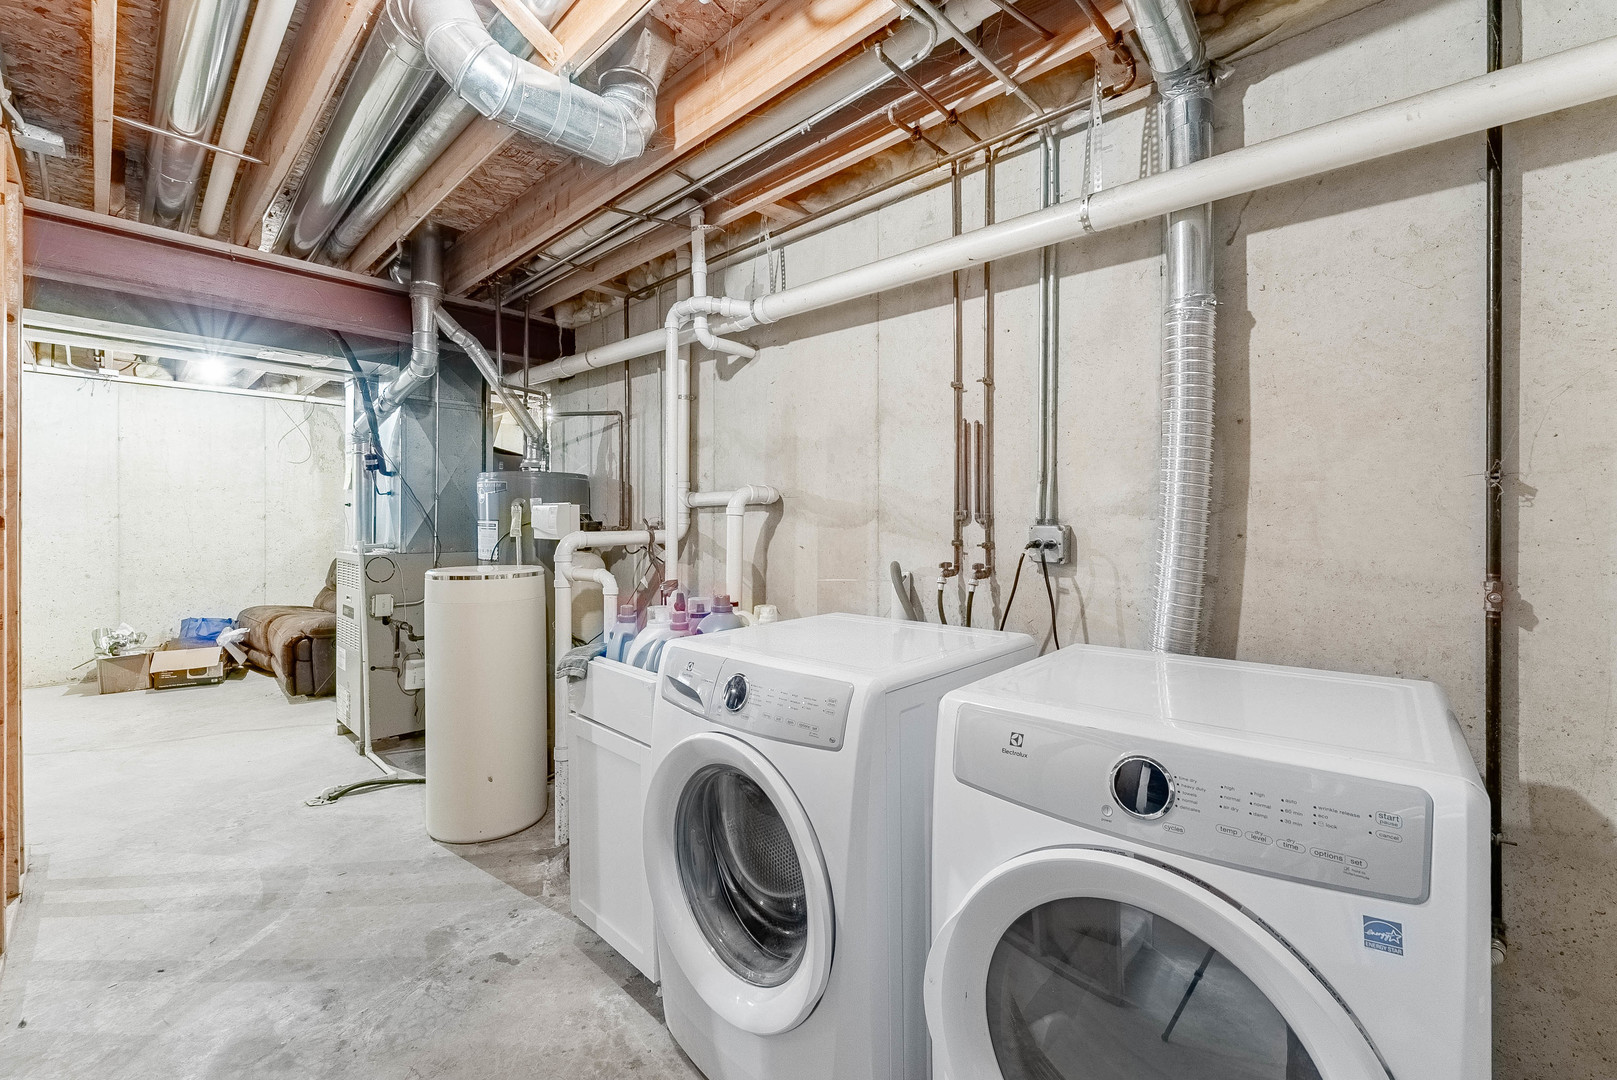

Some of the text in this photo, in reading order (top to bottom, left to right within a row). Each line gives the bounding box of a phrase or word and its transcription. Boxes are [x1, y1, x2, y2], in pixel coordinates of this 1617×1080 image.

[1001, 747, 1029, 759] Electrolux
[1223, 795, 1241, 803] normal
[1253, 801, 1272, 810] normal
[1252, 811, 1269, 820] damp
[1317, 805, 1361, 819] wrinkle release
[1378, 812, 1400, 823] start
[1163, 822, 1185, 834] cycles
[1325, 822, 1338, 830] lock
[1379, 819, 1399, 828] pause
[1219, 826, 1239, 837] temp
[1250, 833, 1268, 843] level
[1378, 832, 1401, 842] cancel
[1282, 841, 1300, 851] time
[1313, 849, 1344, 862] options
[1350, 858, 1364, 867] set
[1365, 940, 1404, 955] ENERGY STAR
